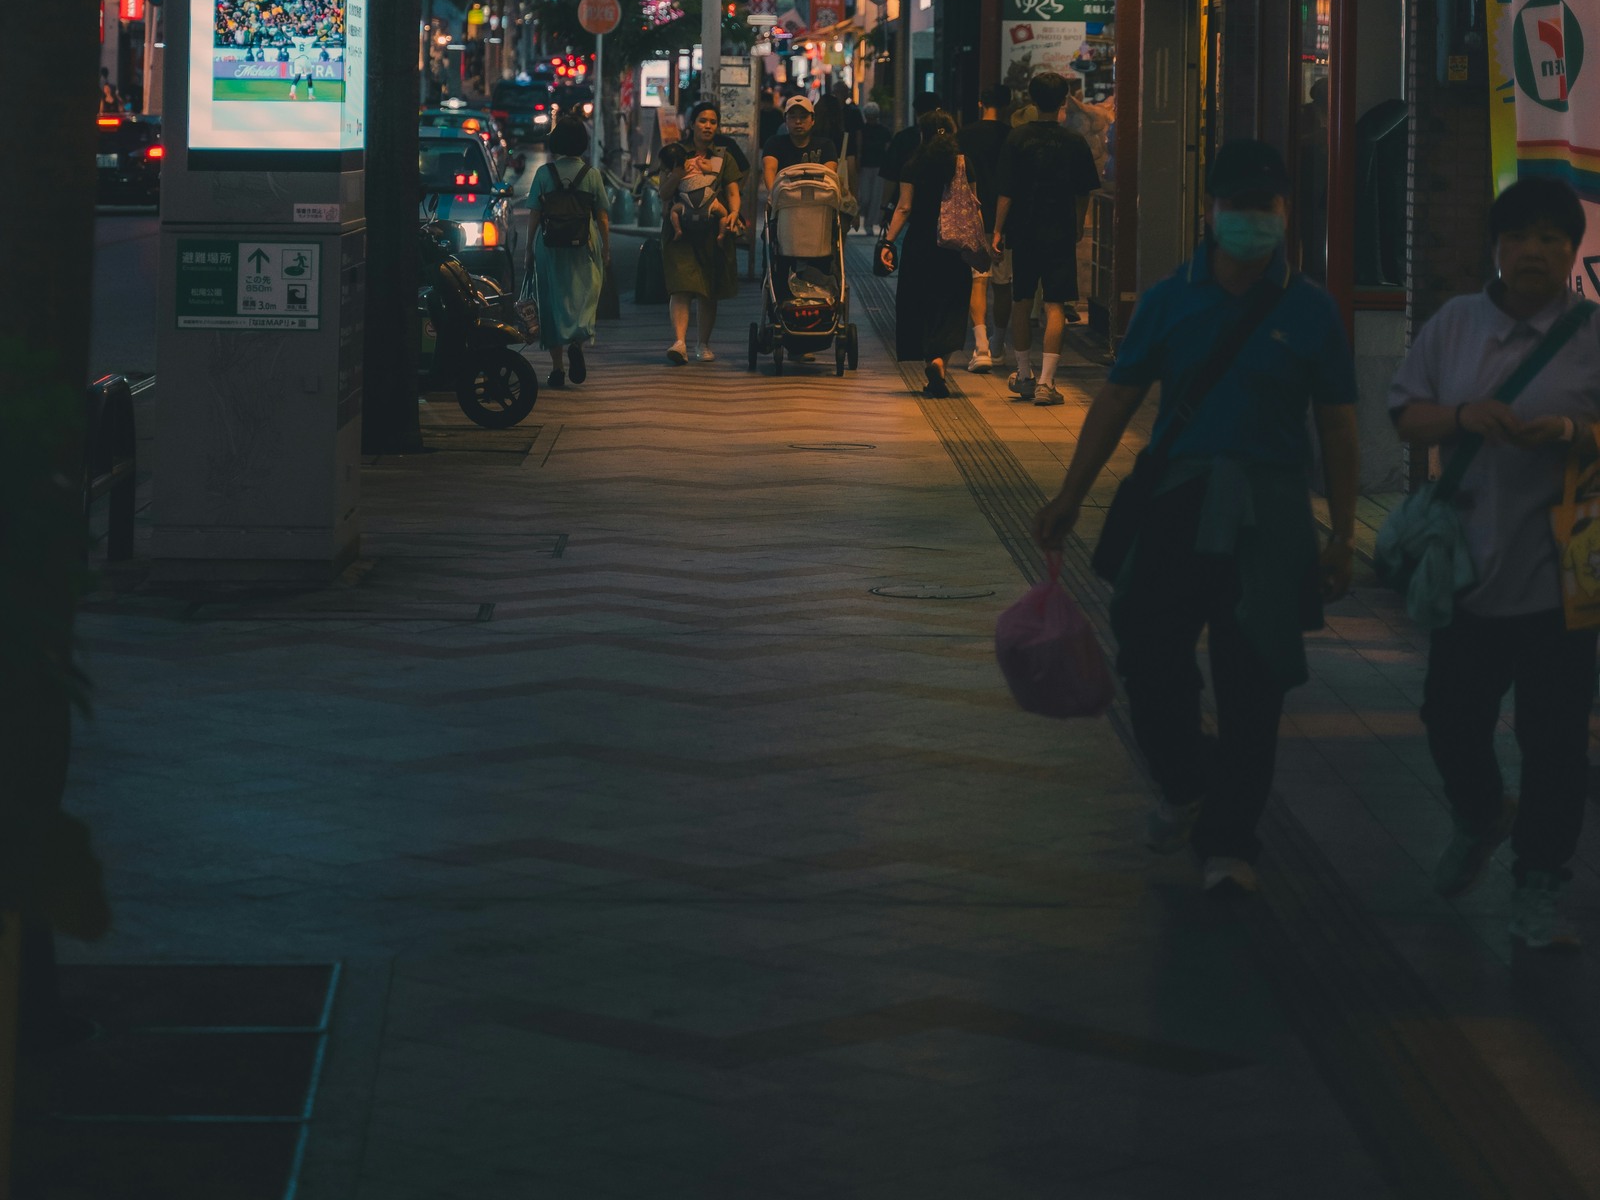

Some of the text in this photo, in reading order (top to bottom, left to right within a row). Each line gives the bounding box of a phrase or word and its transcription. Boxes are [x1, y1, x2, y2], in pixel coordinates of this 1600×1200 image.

[1036, 33, 1083, 42] PHOTO SPOT
[182, 251, 232, 264] 避難場所
[245, 275, 272, 285] この先
